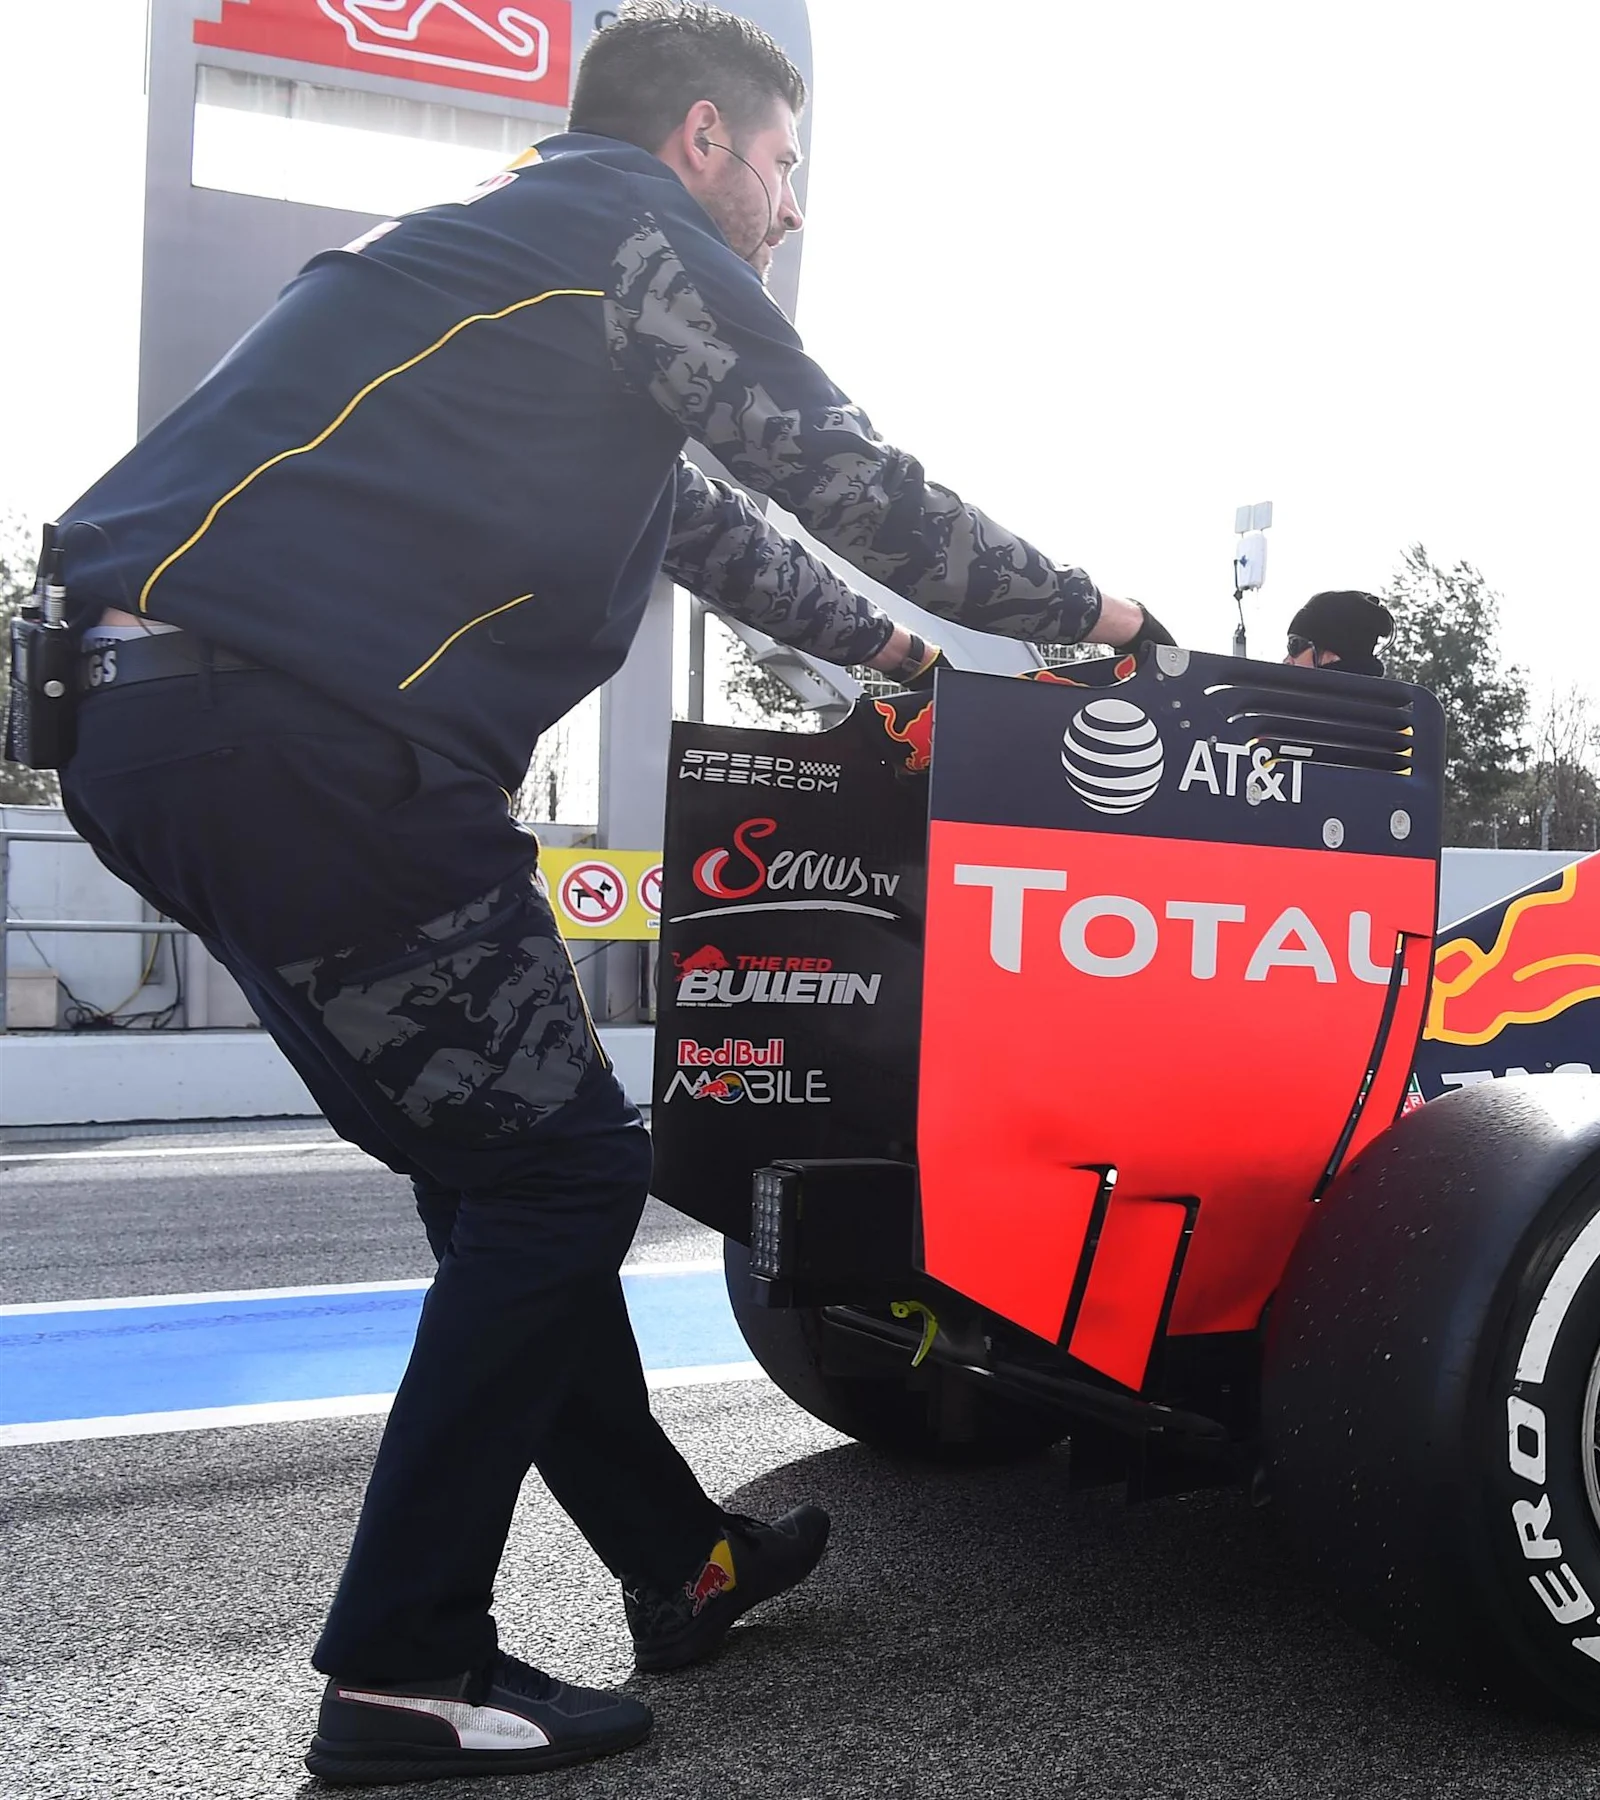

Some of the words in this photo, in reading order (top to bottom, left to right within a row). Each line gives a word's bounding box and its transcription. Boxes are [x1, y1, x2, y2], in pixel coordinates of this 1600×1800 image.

[682, 749, 794, 772] SPEED
[1178, 740, 1314, 803] AT&T
[678, 766, 839, 793] WEEK.COM
[692, 817, 868, 899] Servus
[871, 872, 900, 897] TV
[953, 863, 1409, 986] TOTAL
[736, 955, 784, 971] THE
[784, 957, 832, 972] RED
[677, 1037, 733, 1067] Red
[733, 1037, 785, 1067] Bull
[664, 1069, 831, 1105] MOBILE
